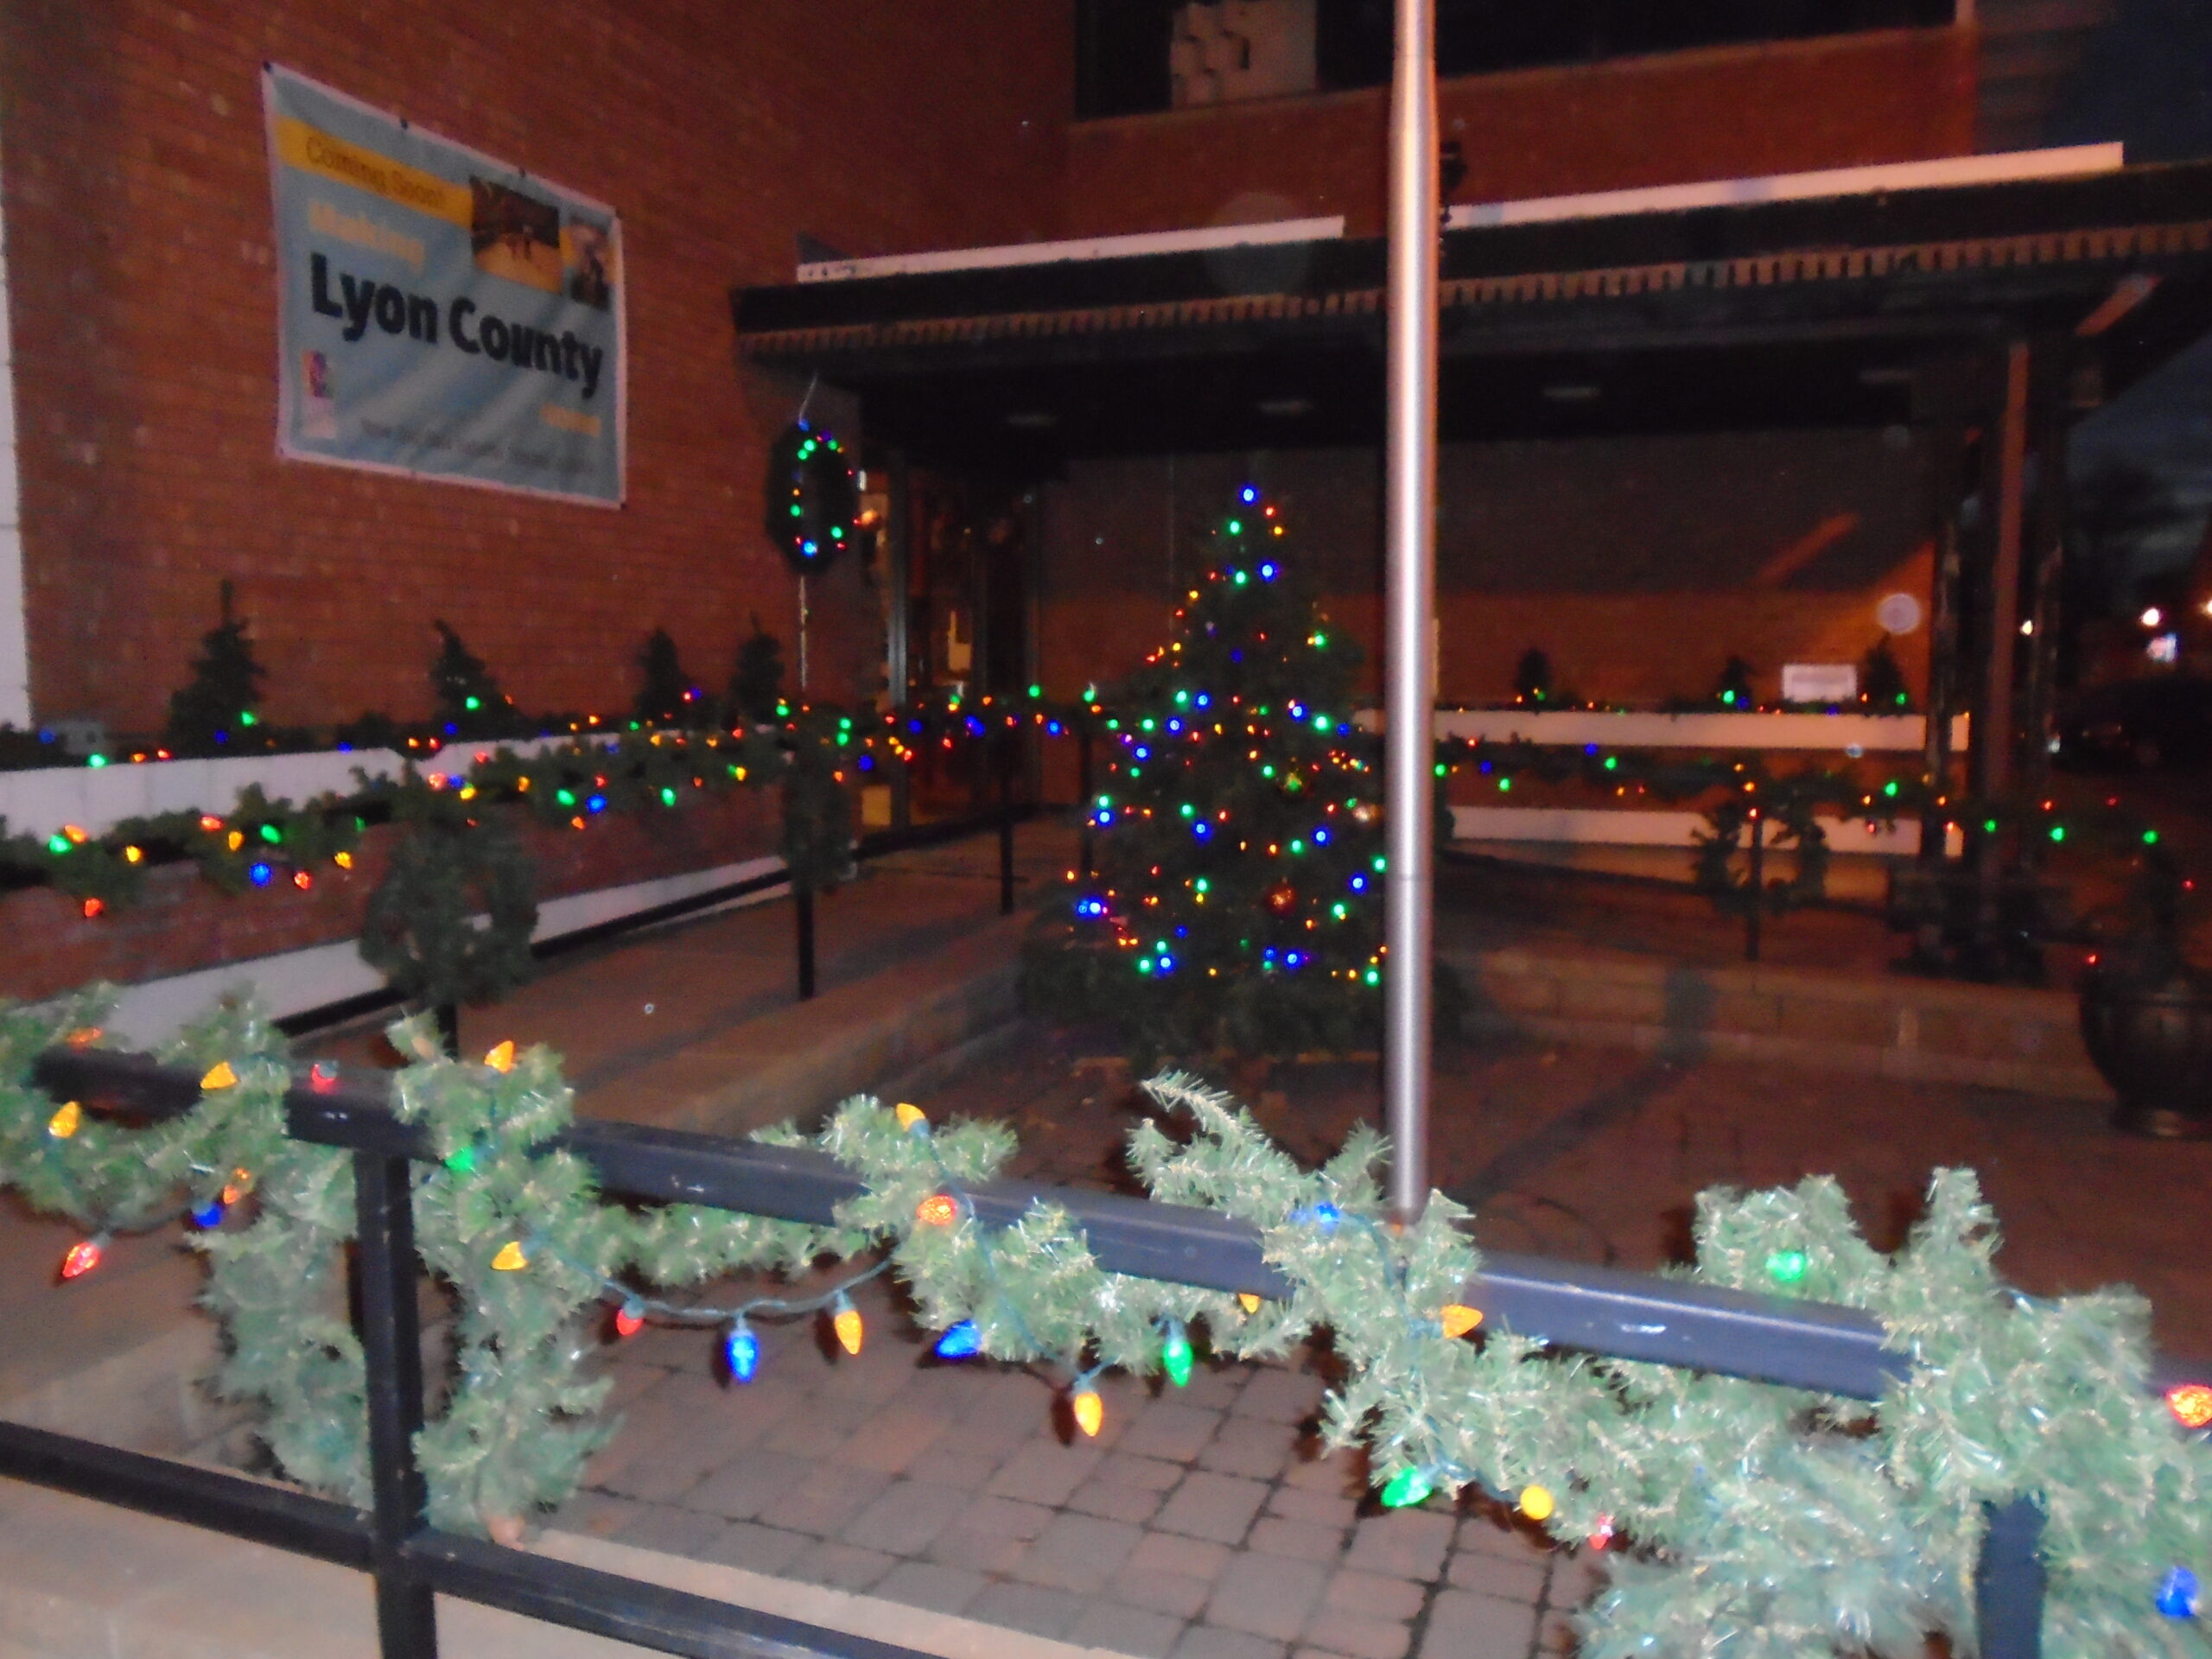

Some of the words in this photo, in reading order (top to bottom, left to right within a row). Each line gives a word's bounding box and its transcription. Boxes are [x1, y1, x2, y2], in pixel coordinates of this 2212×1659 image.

[306, 136, 388, 196] Coming
[310, 251, 438, 343] Lyon
[448, 296, 603, 400] County
